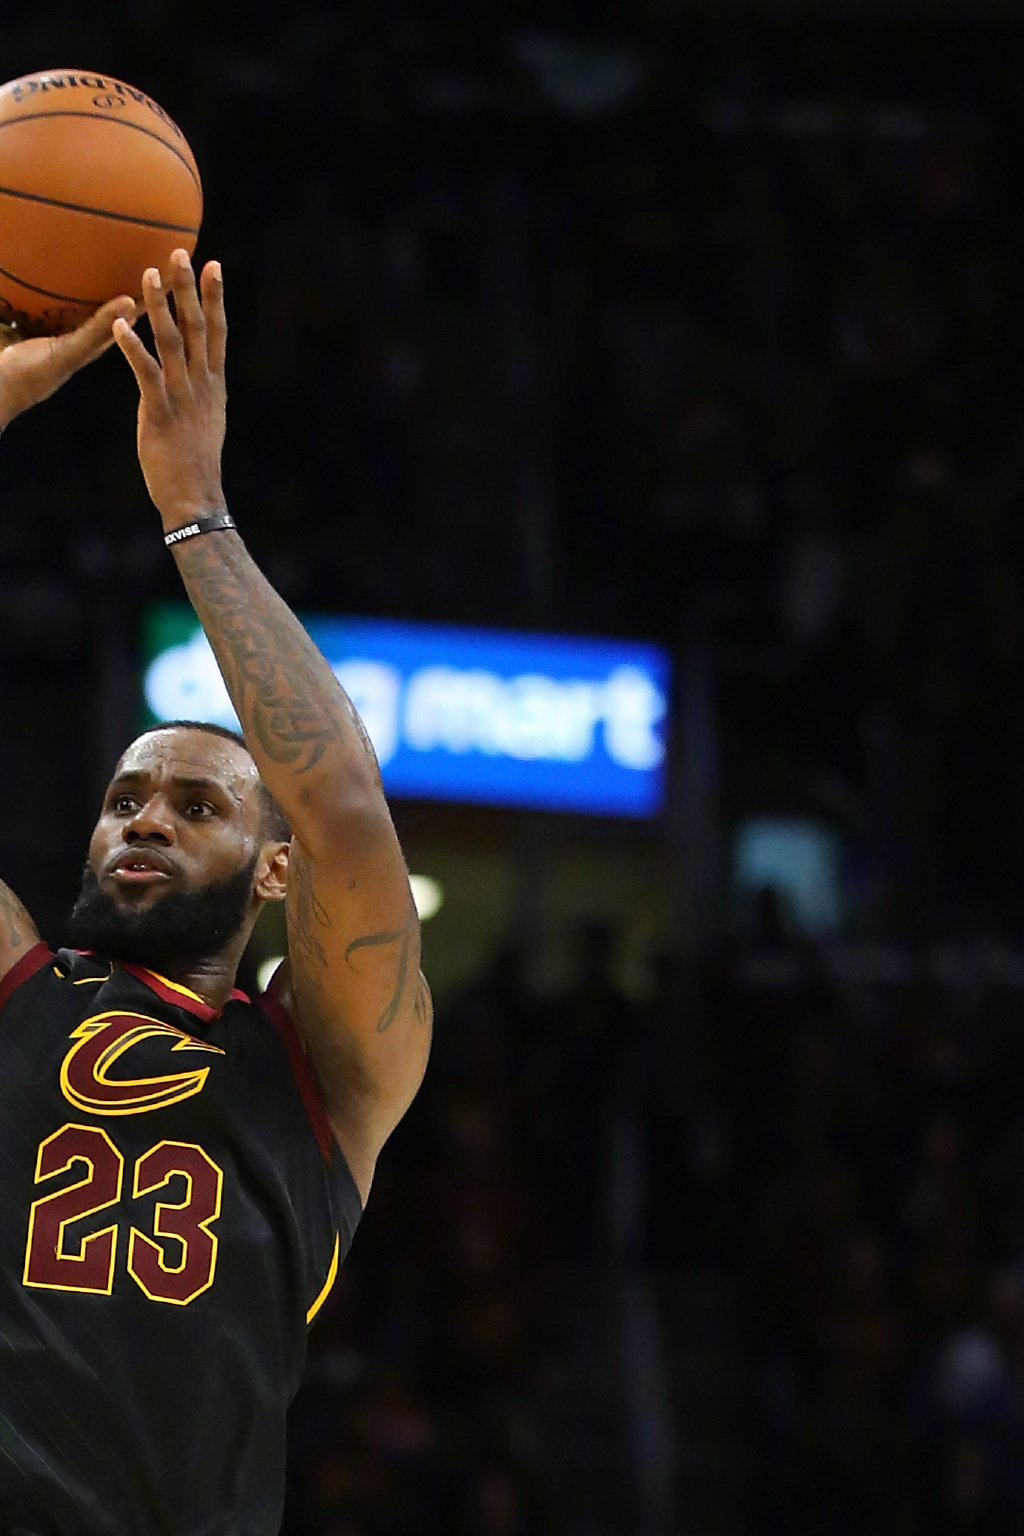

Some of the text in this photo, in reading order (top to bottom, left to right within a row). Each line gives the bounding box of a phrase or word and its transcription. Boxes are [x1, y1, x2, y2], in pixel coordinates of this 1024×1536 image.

[144, 624, 668, 771] dg mart
[22, 1122, 224, 1306] 23
